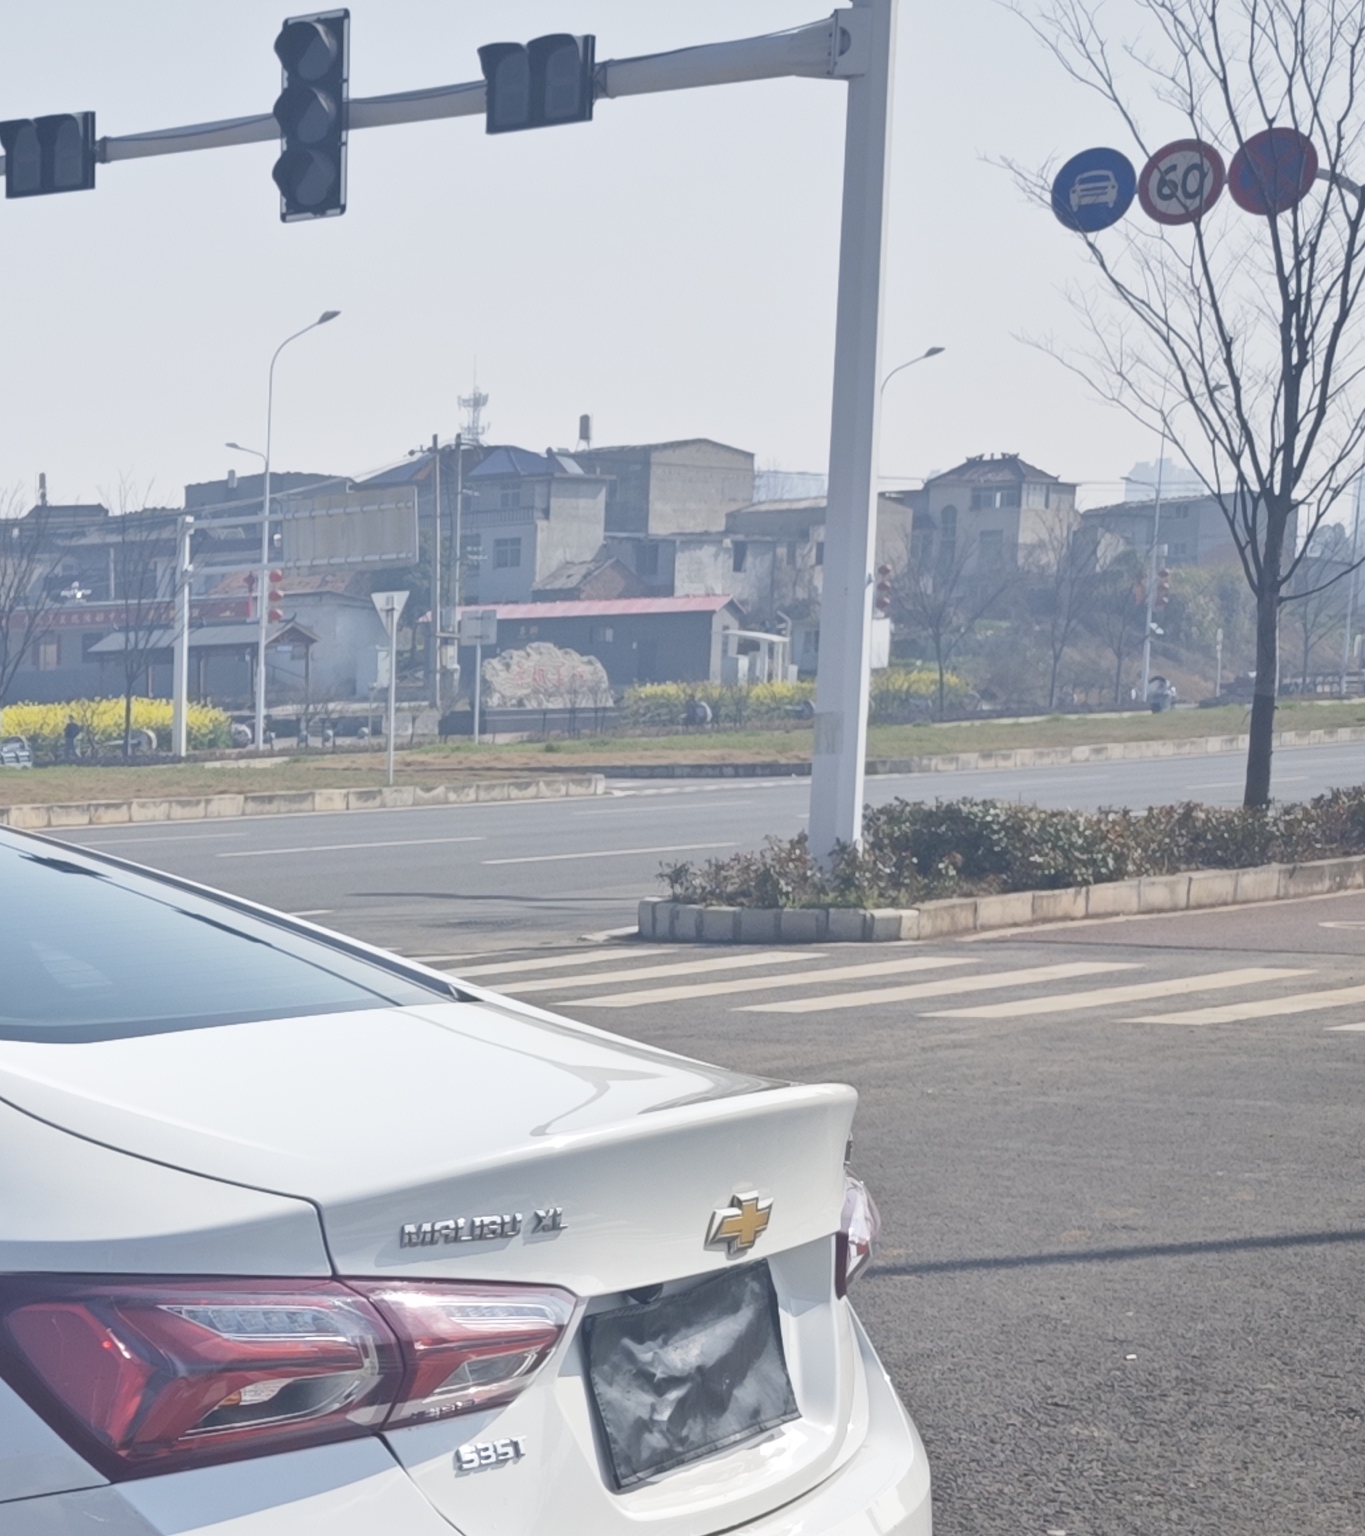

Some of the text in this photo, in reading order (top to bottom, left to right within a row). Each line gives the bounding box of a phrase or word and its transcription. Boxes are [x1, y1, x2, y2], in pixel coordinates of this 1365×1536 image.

[1156, 162, 1204, 201] 60
[400, 1206, 568, 1248] MALIBU XL
[457, 1435, 527, 1471] 535T
